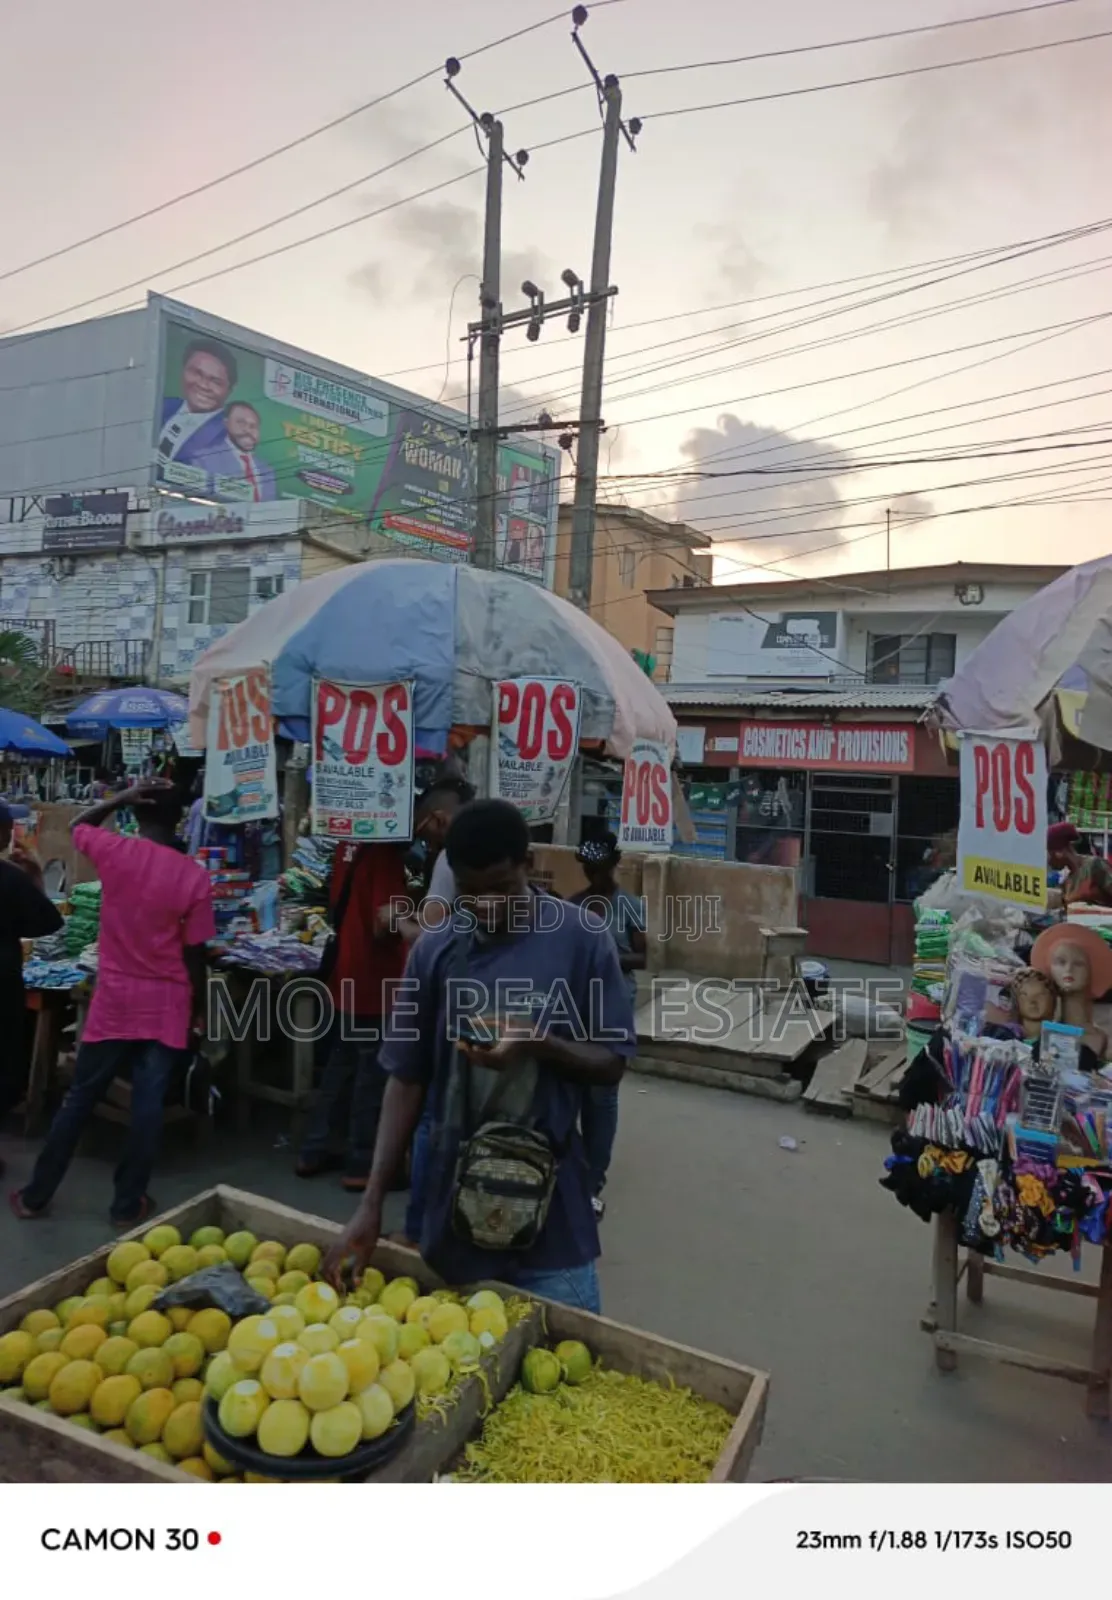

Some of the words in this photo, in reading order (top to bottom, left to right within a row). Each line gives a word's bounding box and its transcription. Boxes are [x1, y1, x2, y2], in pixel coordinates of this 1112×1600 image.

[316, 680, 408, 766] POS
[496, 680, 576, 761] POS
[742, 727, 806, 758] COSMETICS
[837, 730, 909, 764] PROVISIONS
[621, 758, 669, 826] POS
[973, 740, 1036, 834] POS
[630, 827, 666, 843] AVAILABLE
[973, 865, 1041, 897] AVAILABLE
